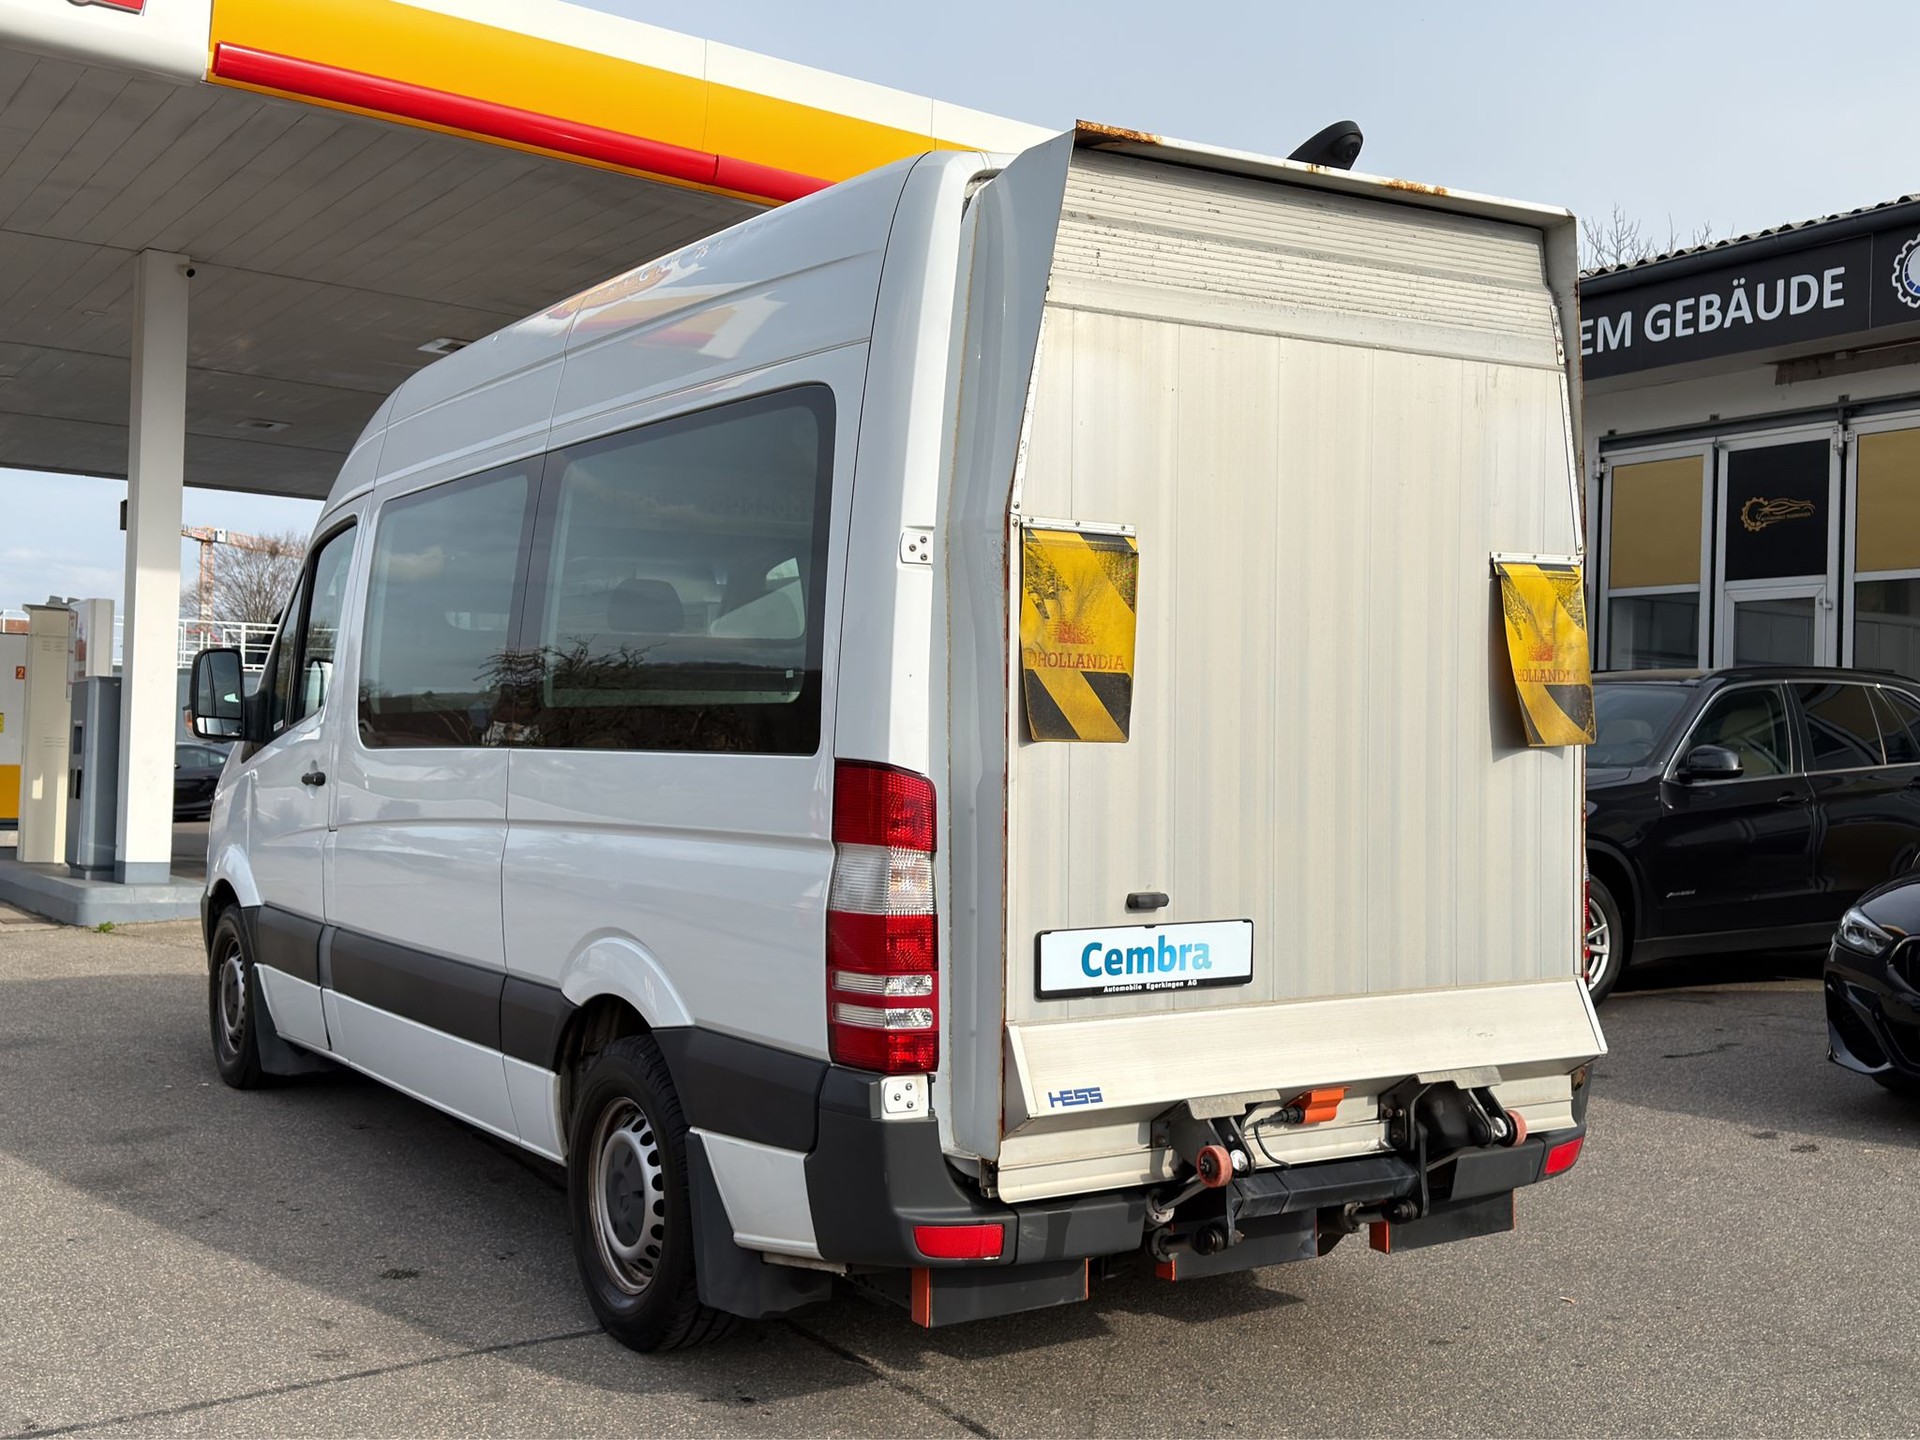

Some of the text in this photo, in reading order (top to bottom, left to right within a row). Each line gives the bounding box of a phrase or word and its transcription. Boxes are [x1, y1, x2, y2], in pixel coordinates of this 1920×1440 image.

[1644, 266, 1846, 342] GEBÄUDE
[17, 667, 25, 679] 2
[1081, 935, 1212, 978] Cembra
[1103, 983, 1143, 993] Automobile
[1146, 981, 1184, 990] Egerkingen
[1048, 1087, 1104, 1108] HESS
